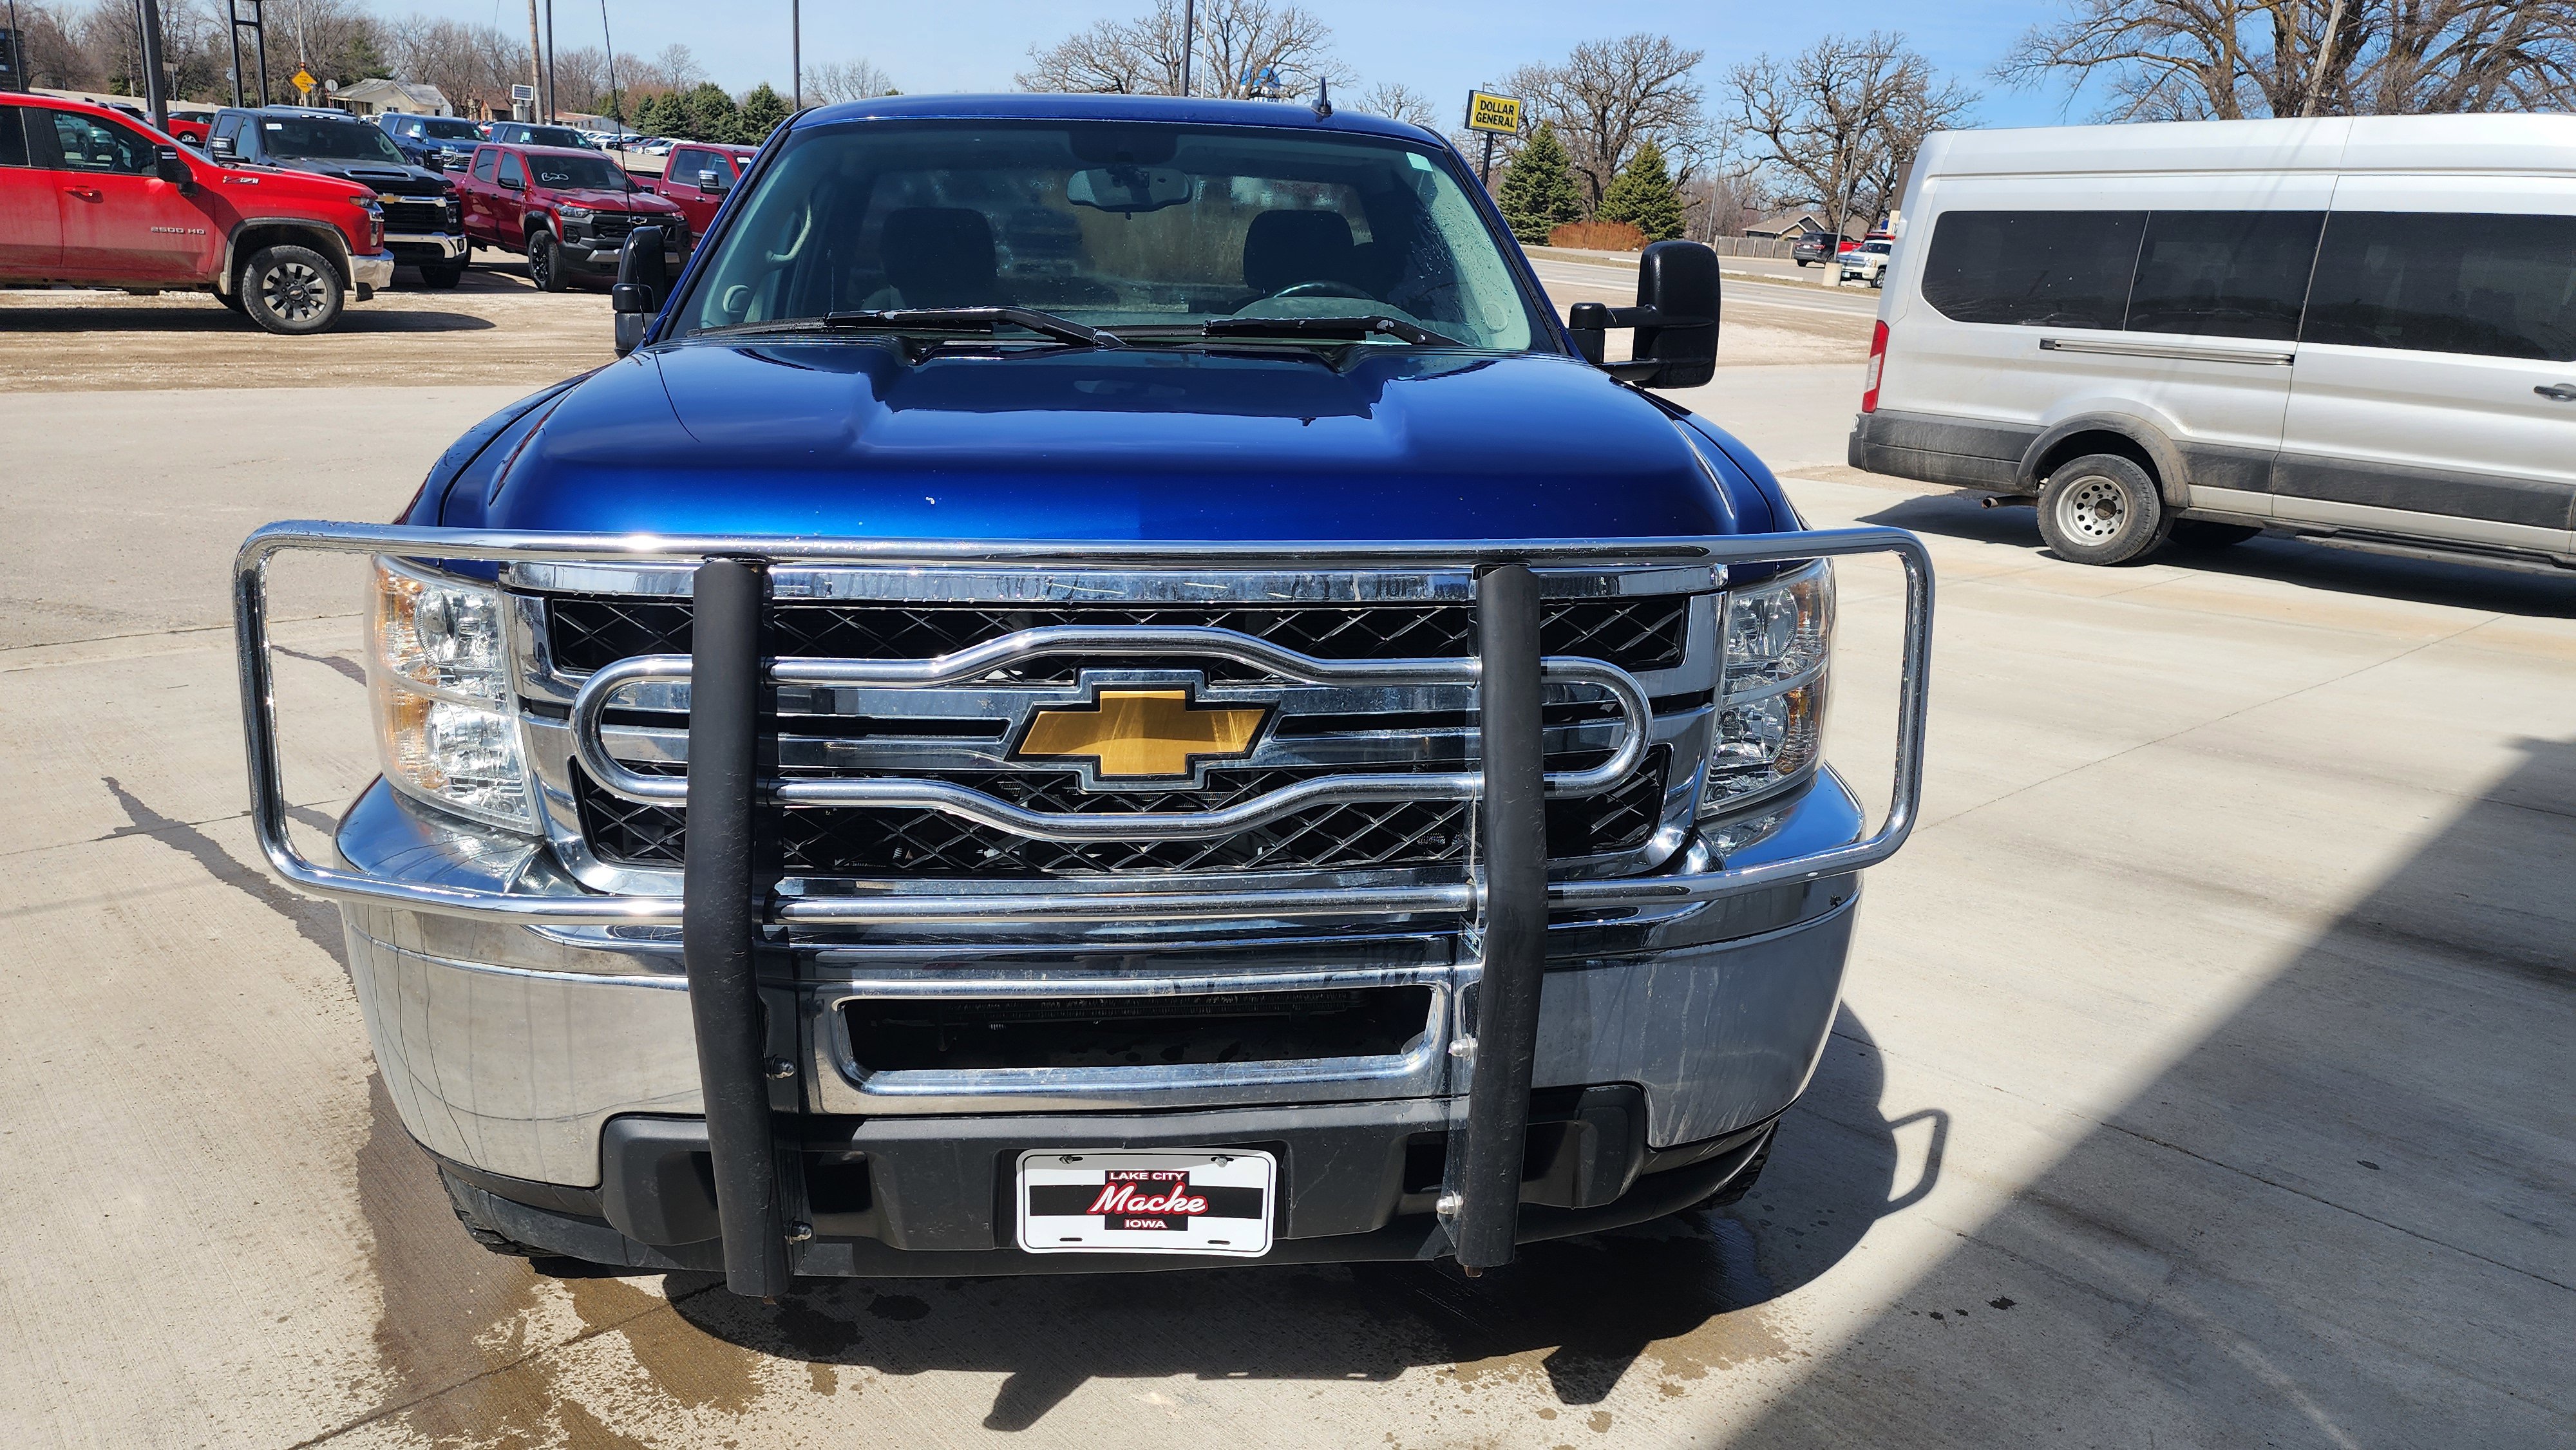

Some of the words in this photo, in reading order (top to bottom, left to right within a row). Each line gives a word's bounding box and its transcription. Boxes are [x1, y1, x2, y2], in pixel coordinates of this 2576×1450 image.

[1480, 100, 1515, 115] DOLLAR
[1475, 111, 1515, 127] GENERAL
[1110, 1172, 1149, 1180] LAKE
[1151, 1172, 1185, 1180] CITY
[1088, 1182, 1208, 1214] Macke
[1125, 1219, 1167, 1229] IOWA
